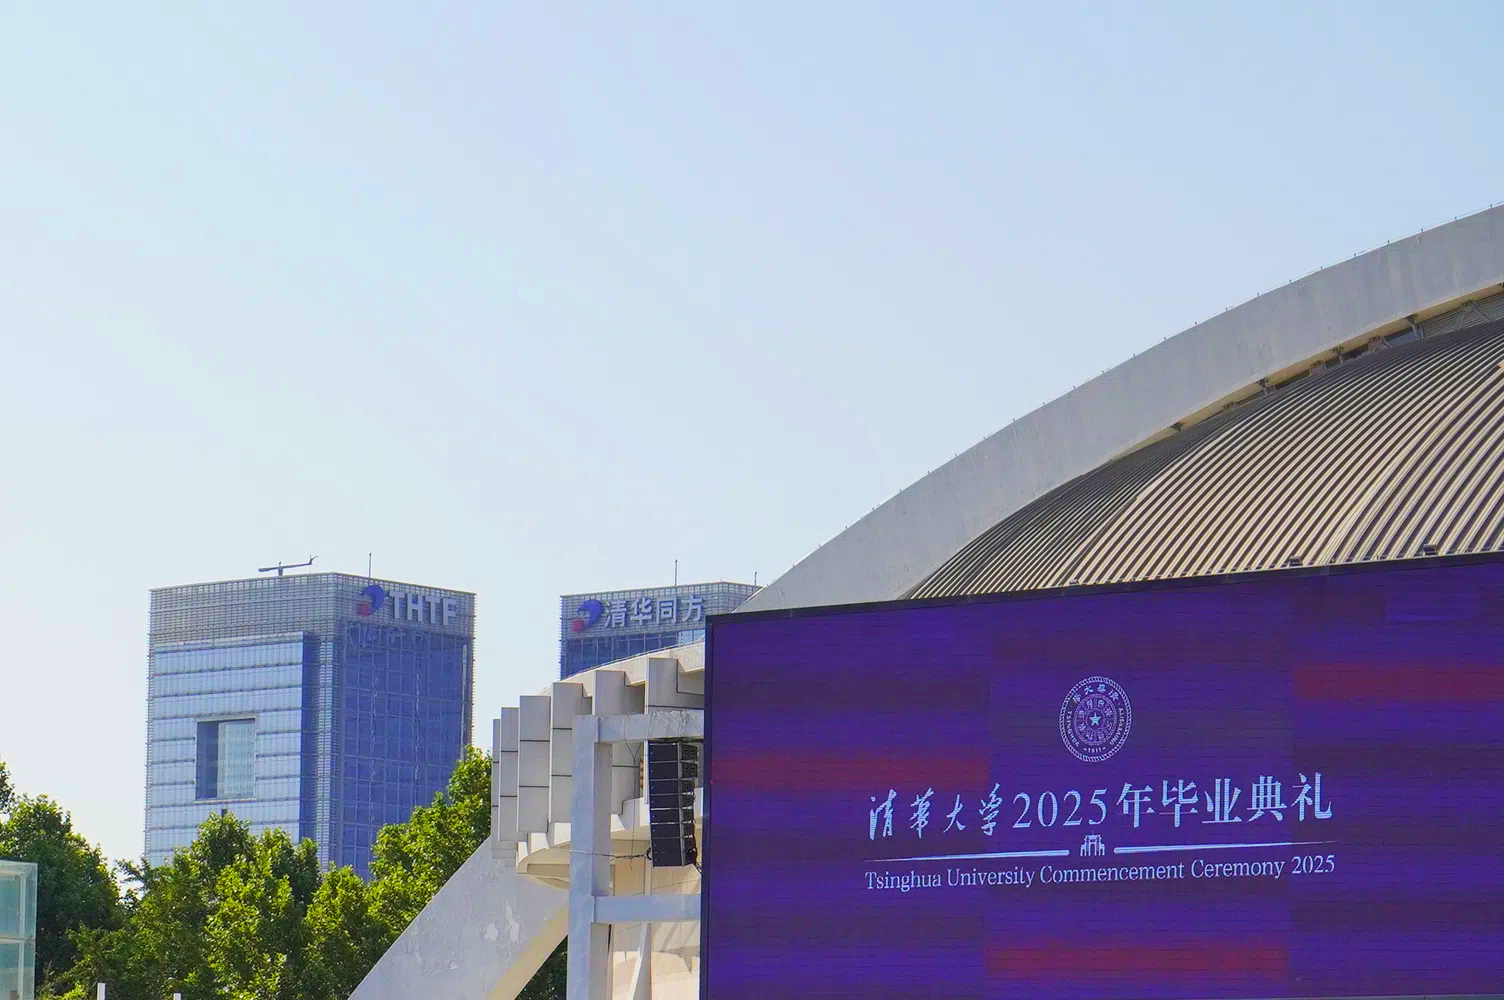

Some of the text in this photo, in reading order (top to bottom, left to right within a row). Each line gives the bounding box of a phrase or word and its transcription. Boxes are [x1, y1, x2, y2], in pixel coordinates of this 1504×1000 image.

[389, 590, 457, 625] THTF
[605, 593, 703, 628] 清华同方
[865, 855, 1335, 892] Tsinghua University Commencement Ceremony 2025
